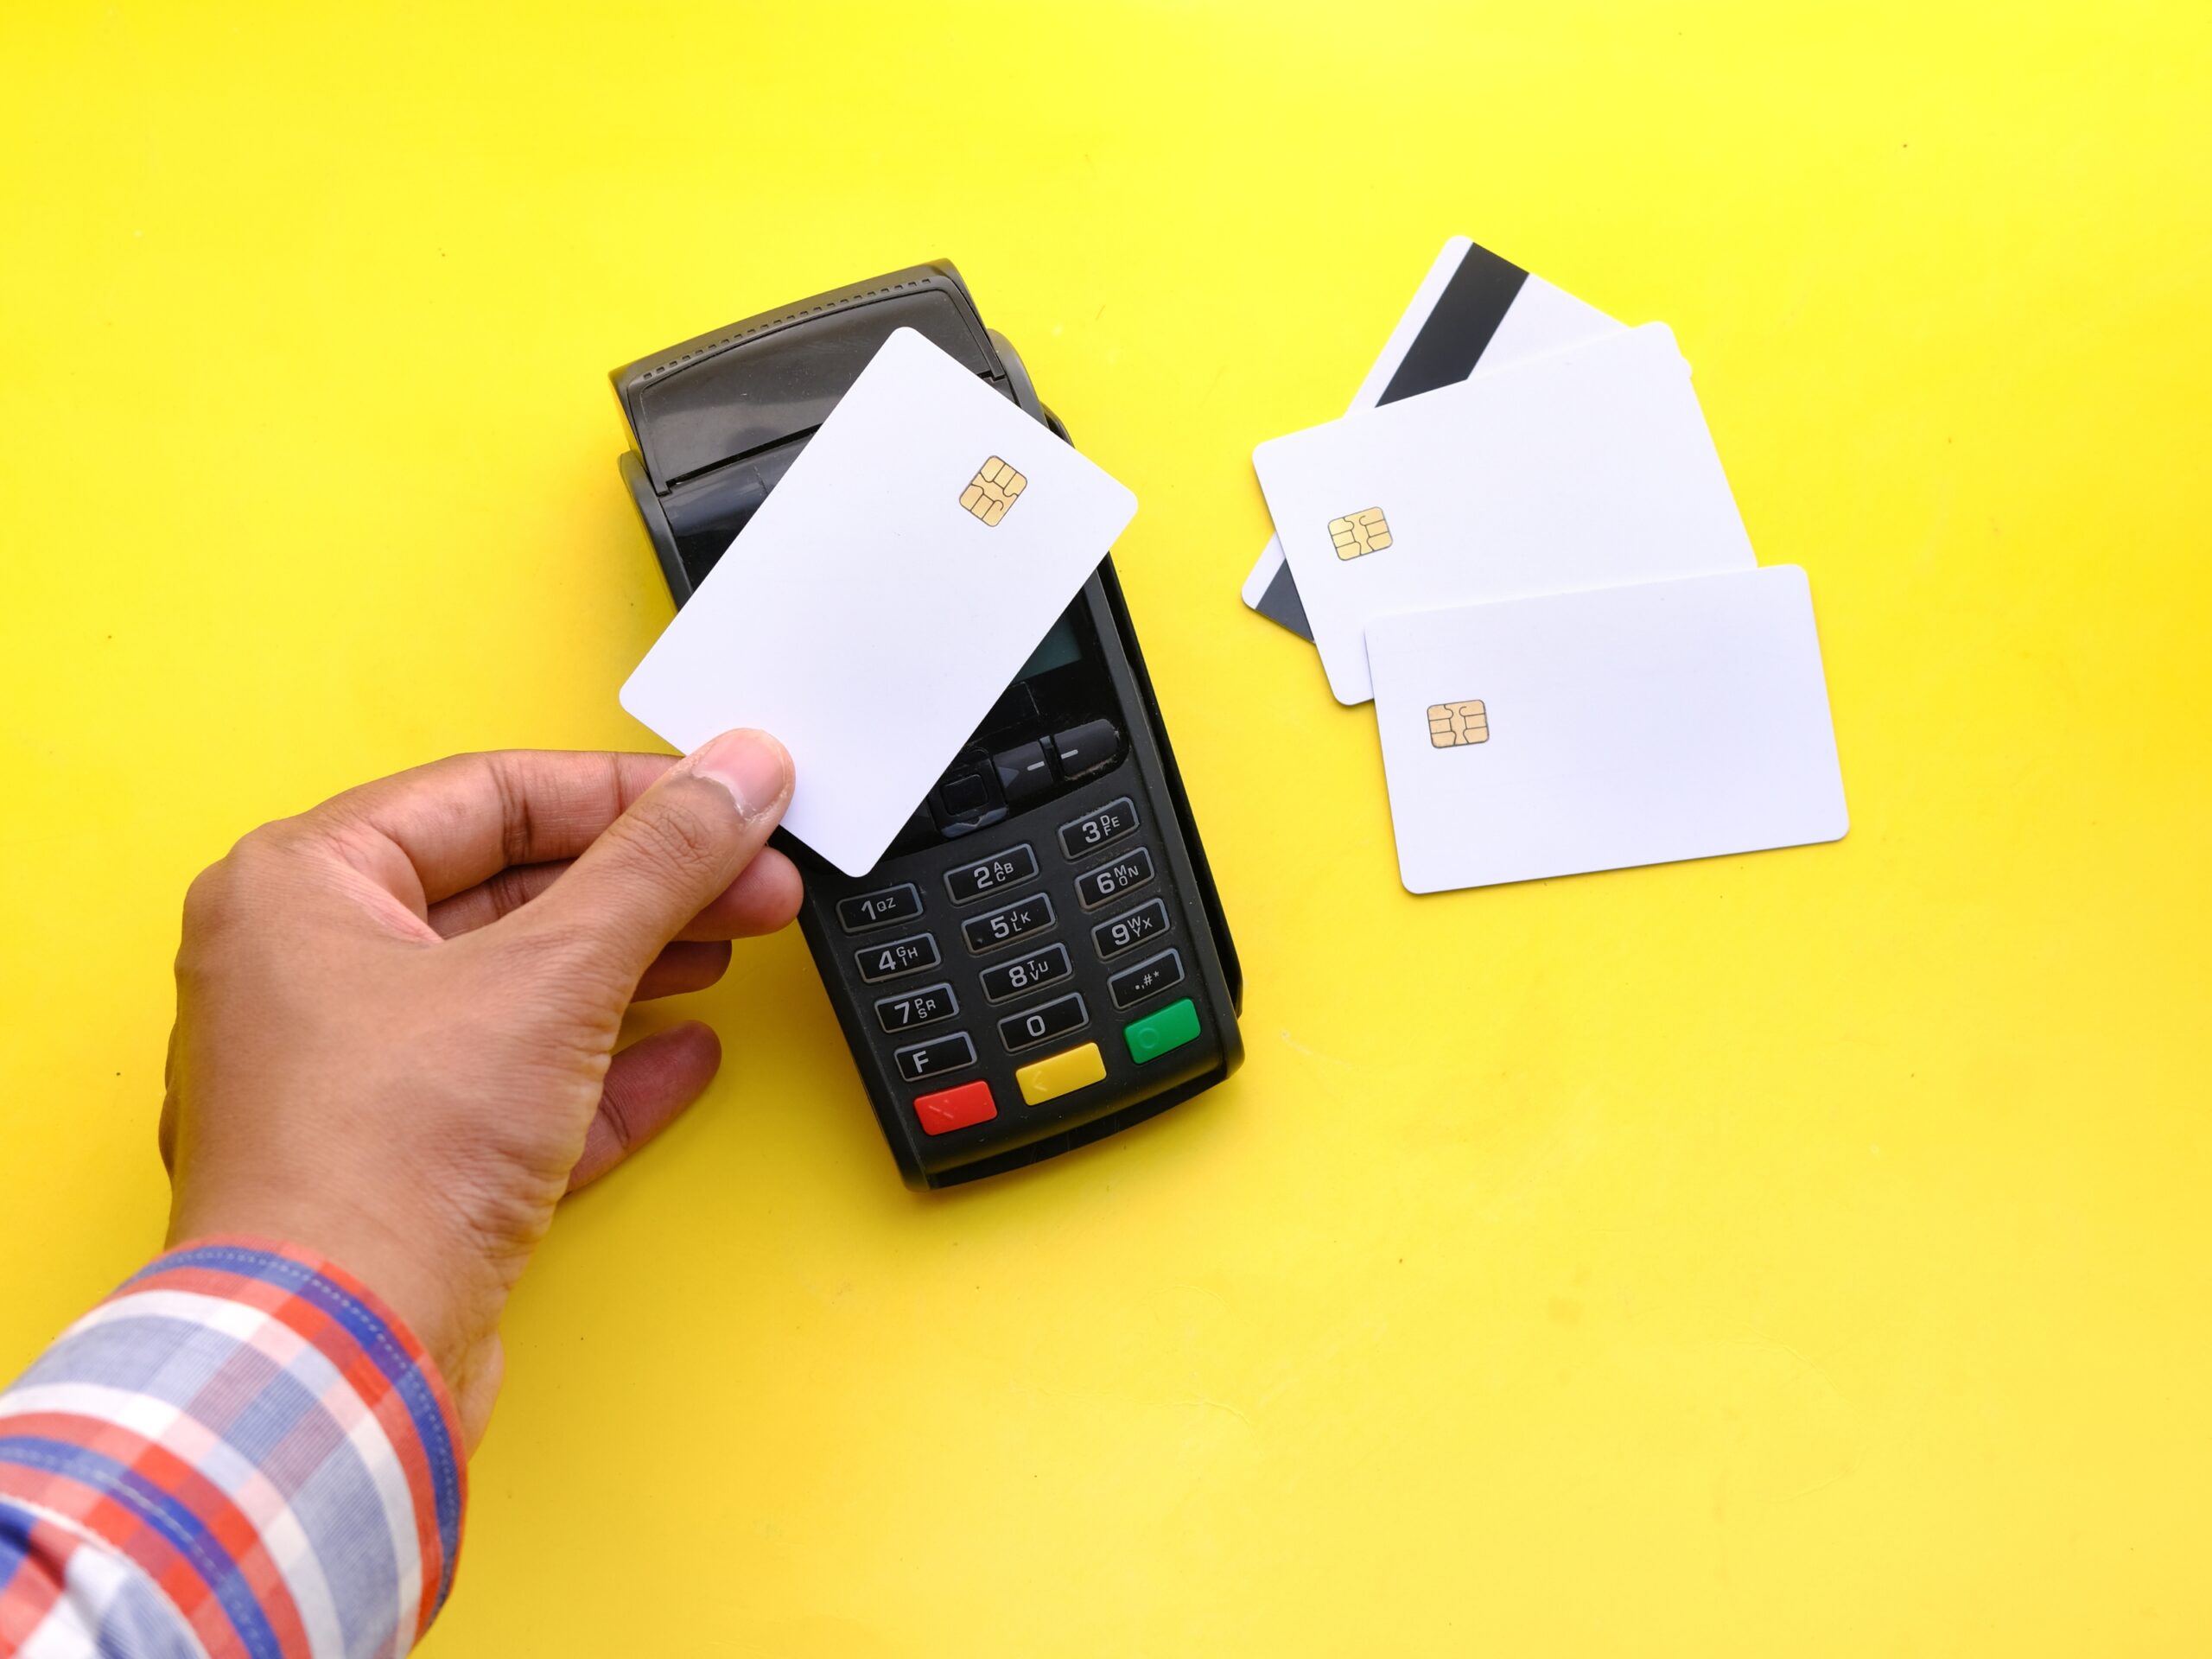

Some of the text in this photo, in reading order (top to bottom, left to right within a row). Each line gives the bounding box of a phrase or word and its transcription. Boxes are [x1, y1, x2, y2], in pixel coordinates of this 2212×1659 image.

[1082, 821, 1101, 843] 3
[974, 866, 993, 889] 2
[1096, 872, 1116, 894] 6
[861, 900, 876, 920] 1
[990, 915, 1009, 938] 5
[1111, 924, 1130, 946] 9
[878, 950, 896, 970] 4
[1008, 965, 1028, 988] 8
[893, 1001, 912, 1024] 7
[912, 1051, 929, 1073] F
